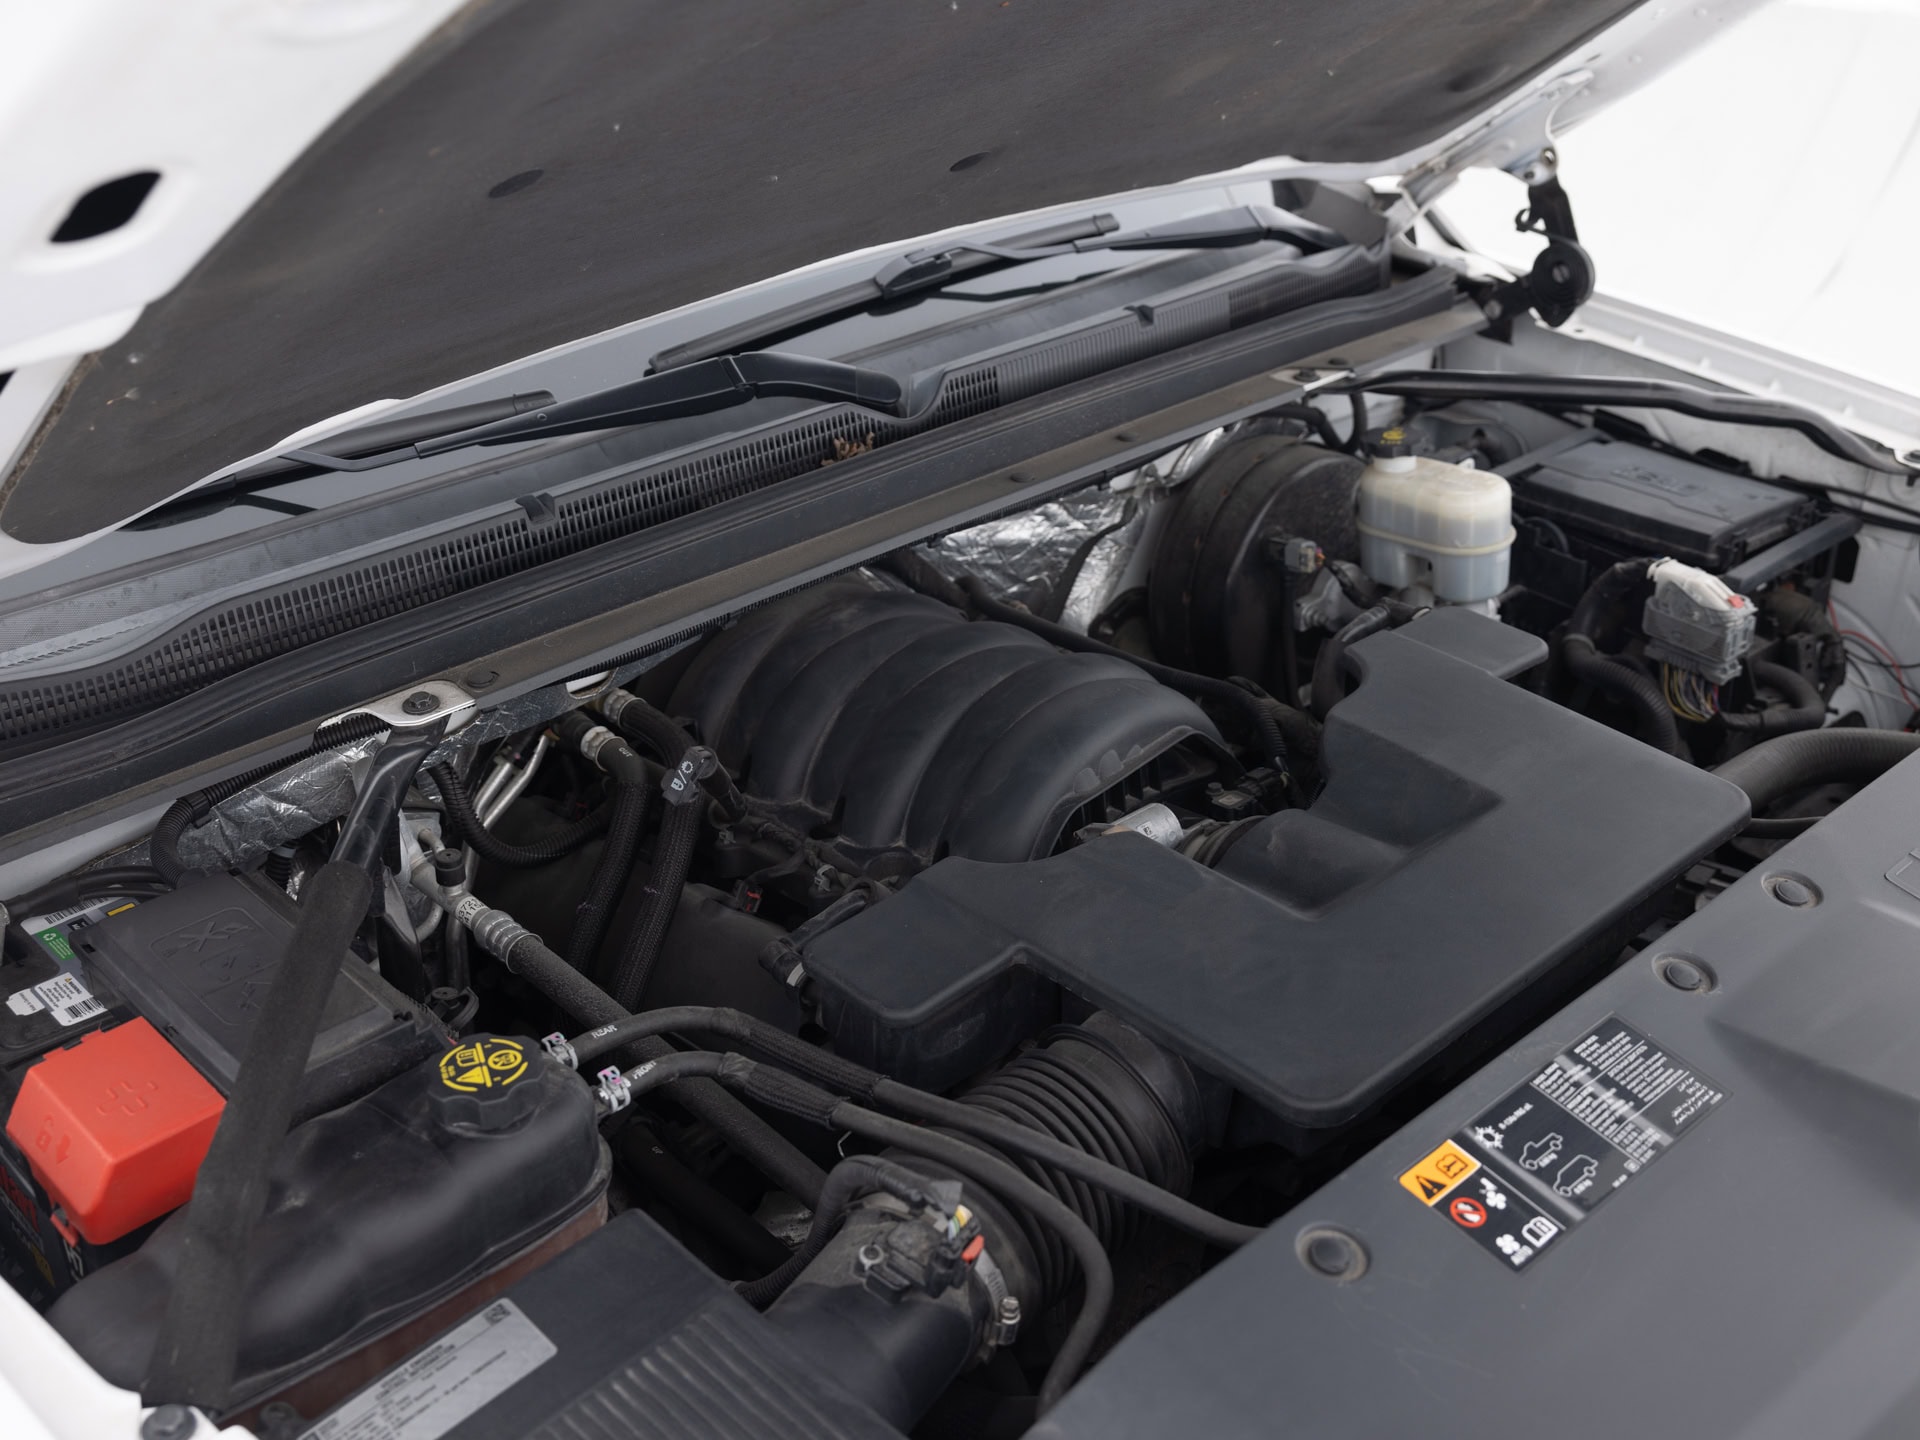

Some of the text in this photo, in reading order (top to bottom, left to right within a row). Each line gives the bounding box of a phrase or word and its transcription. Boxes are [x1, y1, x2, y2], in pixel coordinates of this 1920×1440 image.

[618, 747, 632, 757] OUT
[591, 1024, 618, 1039] REAR
[632, 1060, 657, 1079] FRONT
